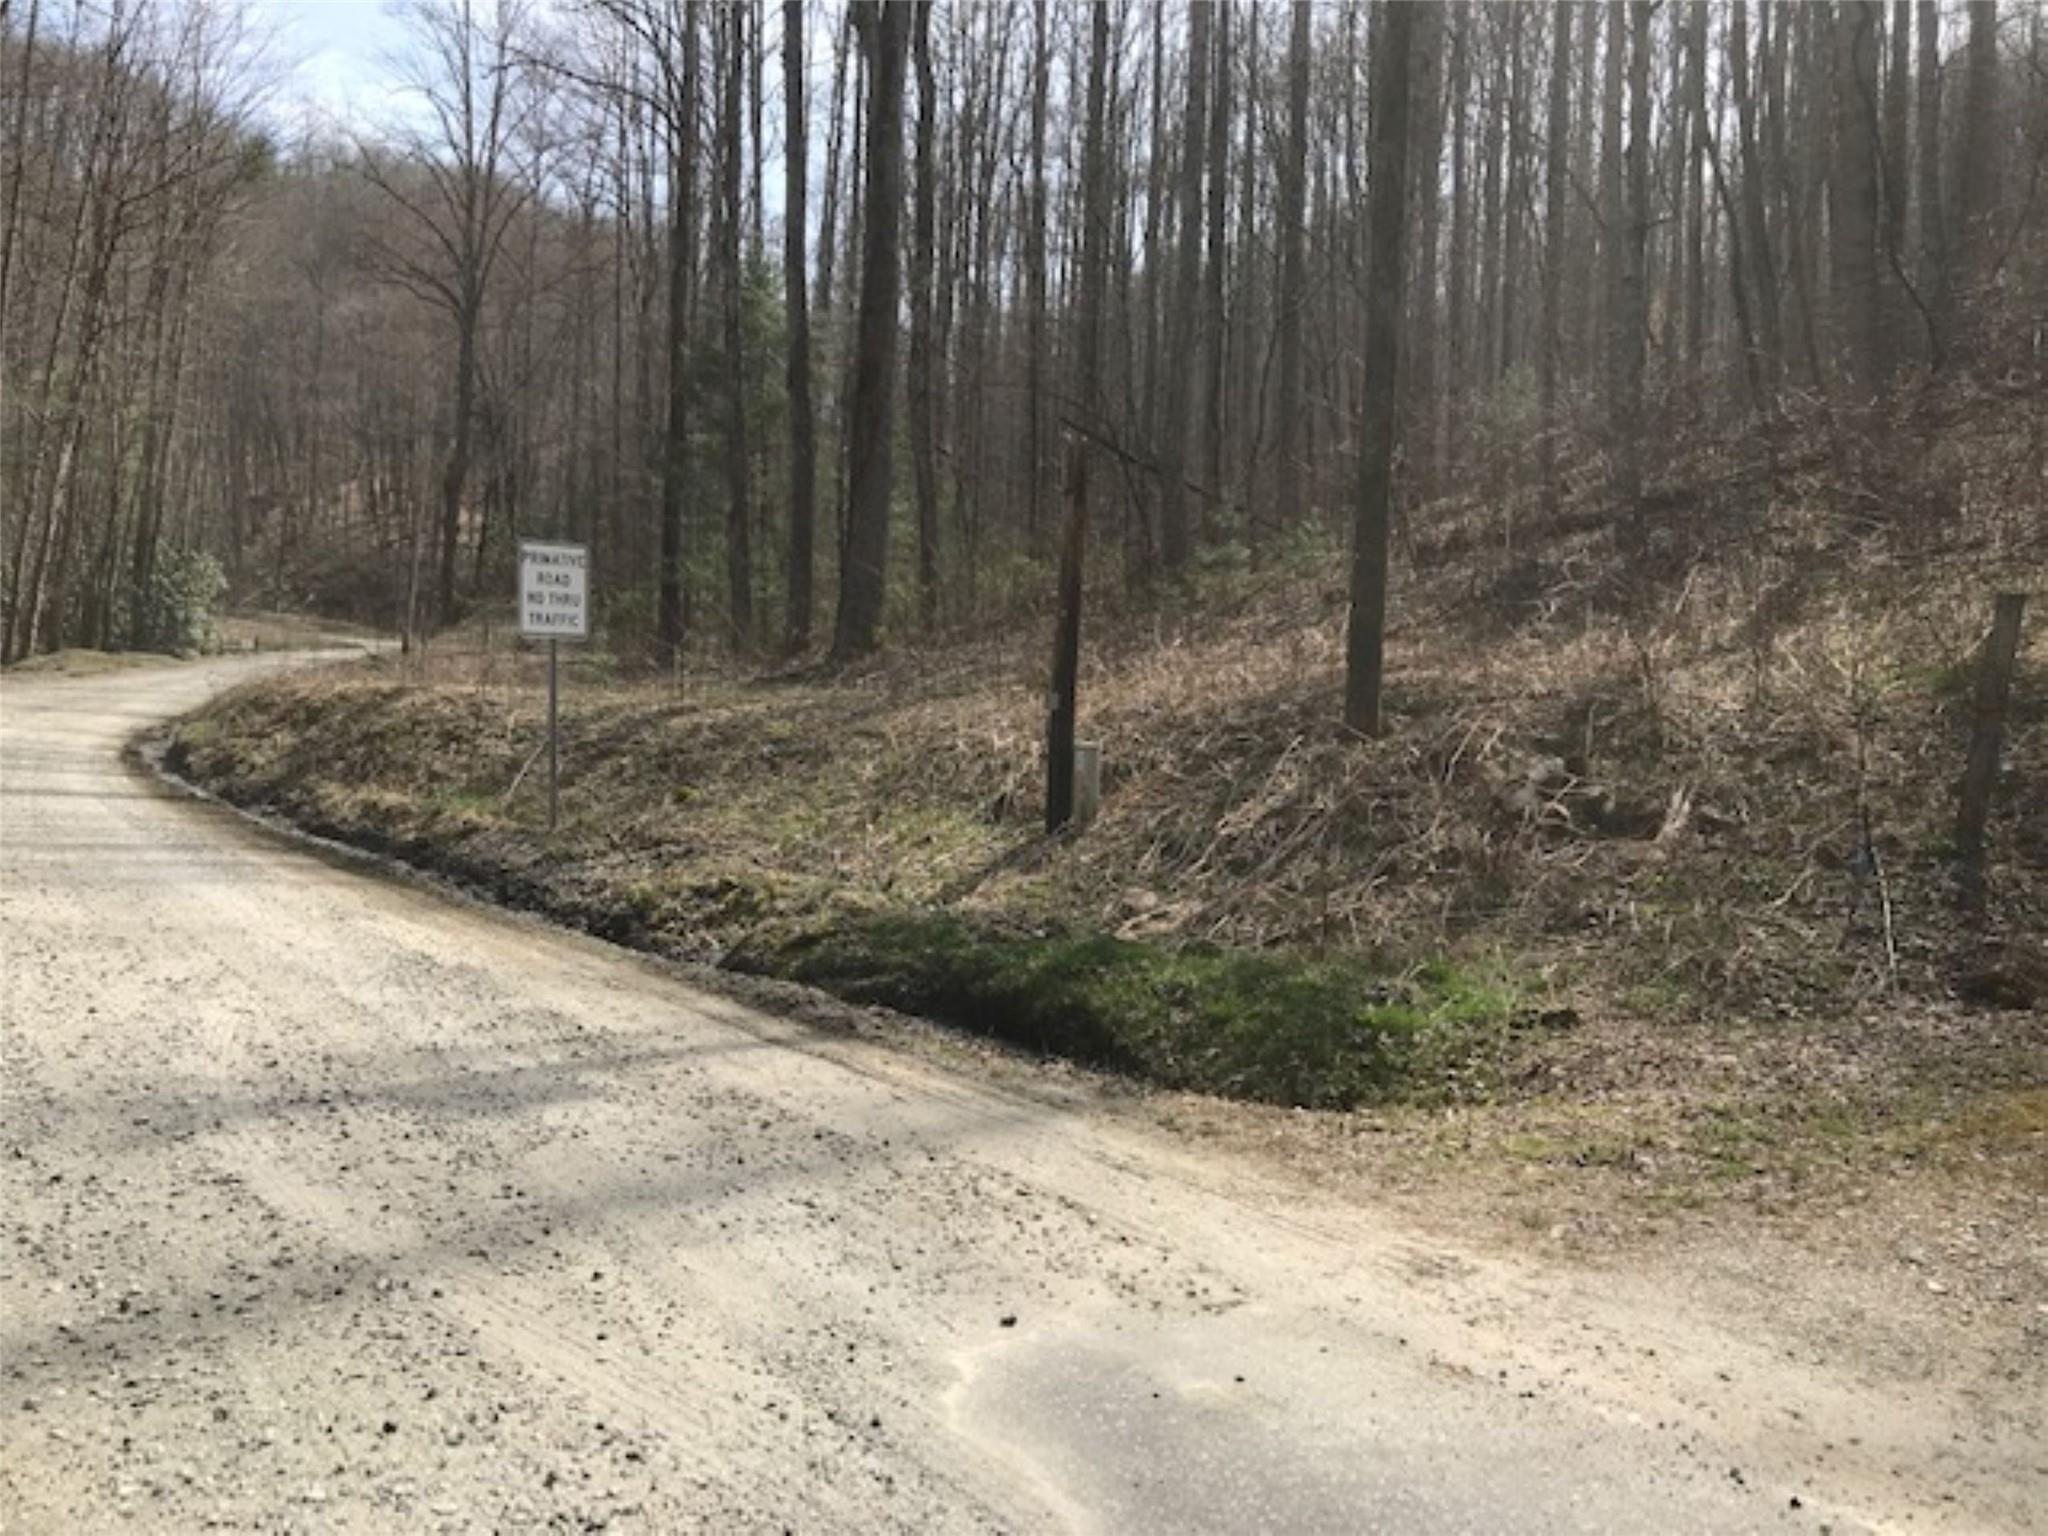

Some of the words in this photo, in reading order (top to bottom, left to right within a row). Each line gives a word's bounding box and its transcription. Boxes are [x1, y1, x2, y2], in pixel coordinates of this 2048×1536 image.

[536, 571, 571, 587] ROAD
[527, 591, 544, 605] NO
[548, 591, 581, 608] THRU
[528, 611, 579, 627] TRAFFIC
